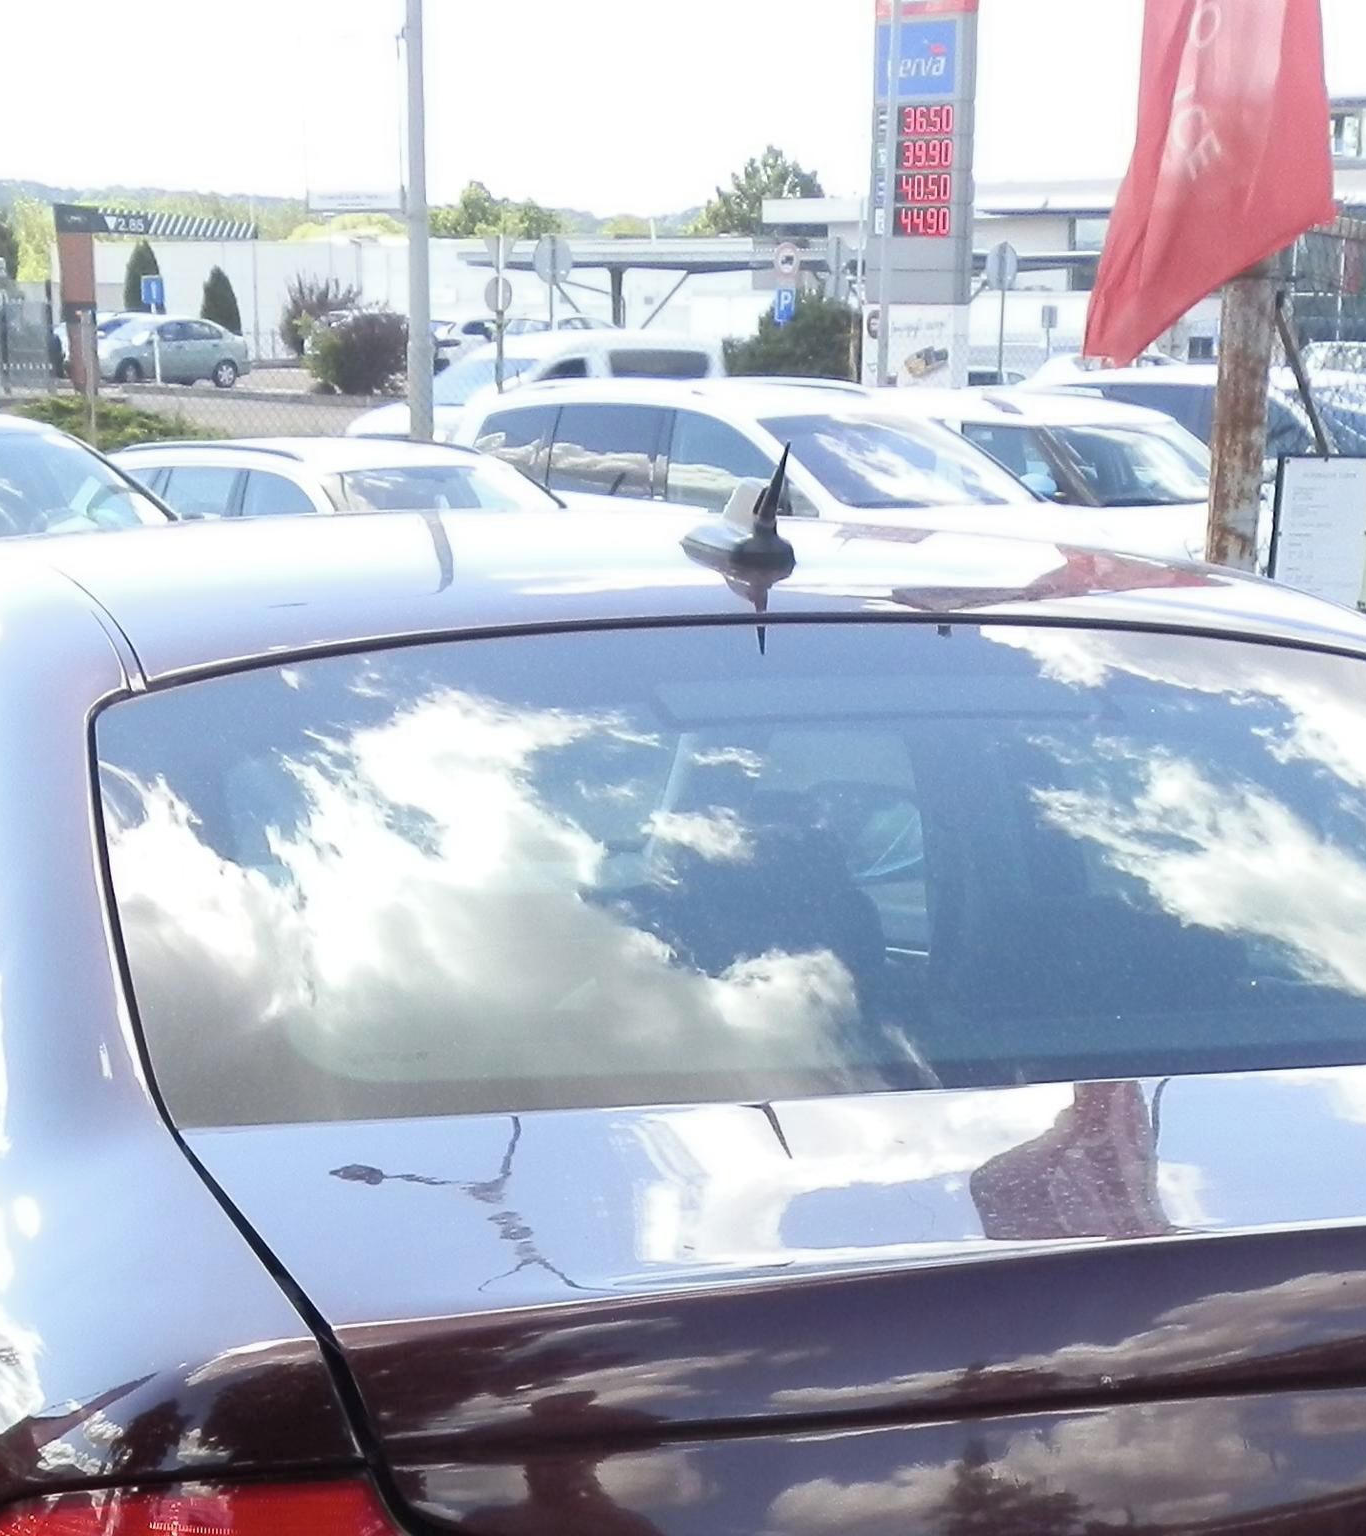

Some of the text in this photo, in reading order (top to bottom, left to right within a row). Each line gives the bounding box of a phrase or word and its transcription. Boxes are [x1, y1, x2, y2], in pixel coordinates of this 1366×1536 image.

[888, 56, 946, 77] erva
[904, 105, 953, 132] 36.50
[903, 140, 952, 167] 39.90
[900, 175, 950, 200] 40.50
[780, 291, 792, 310] P
